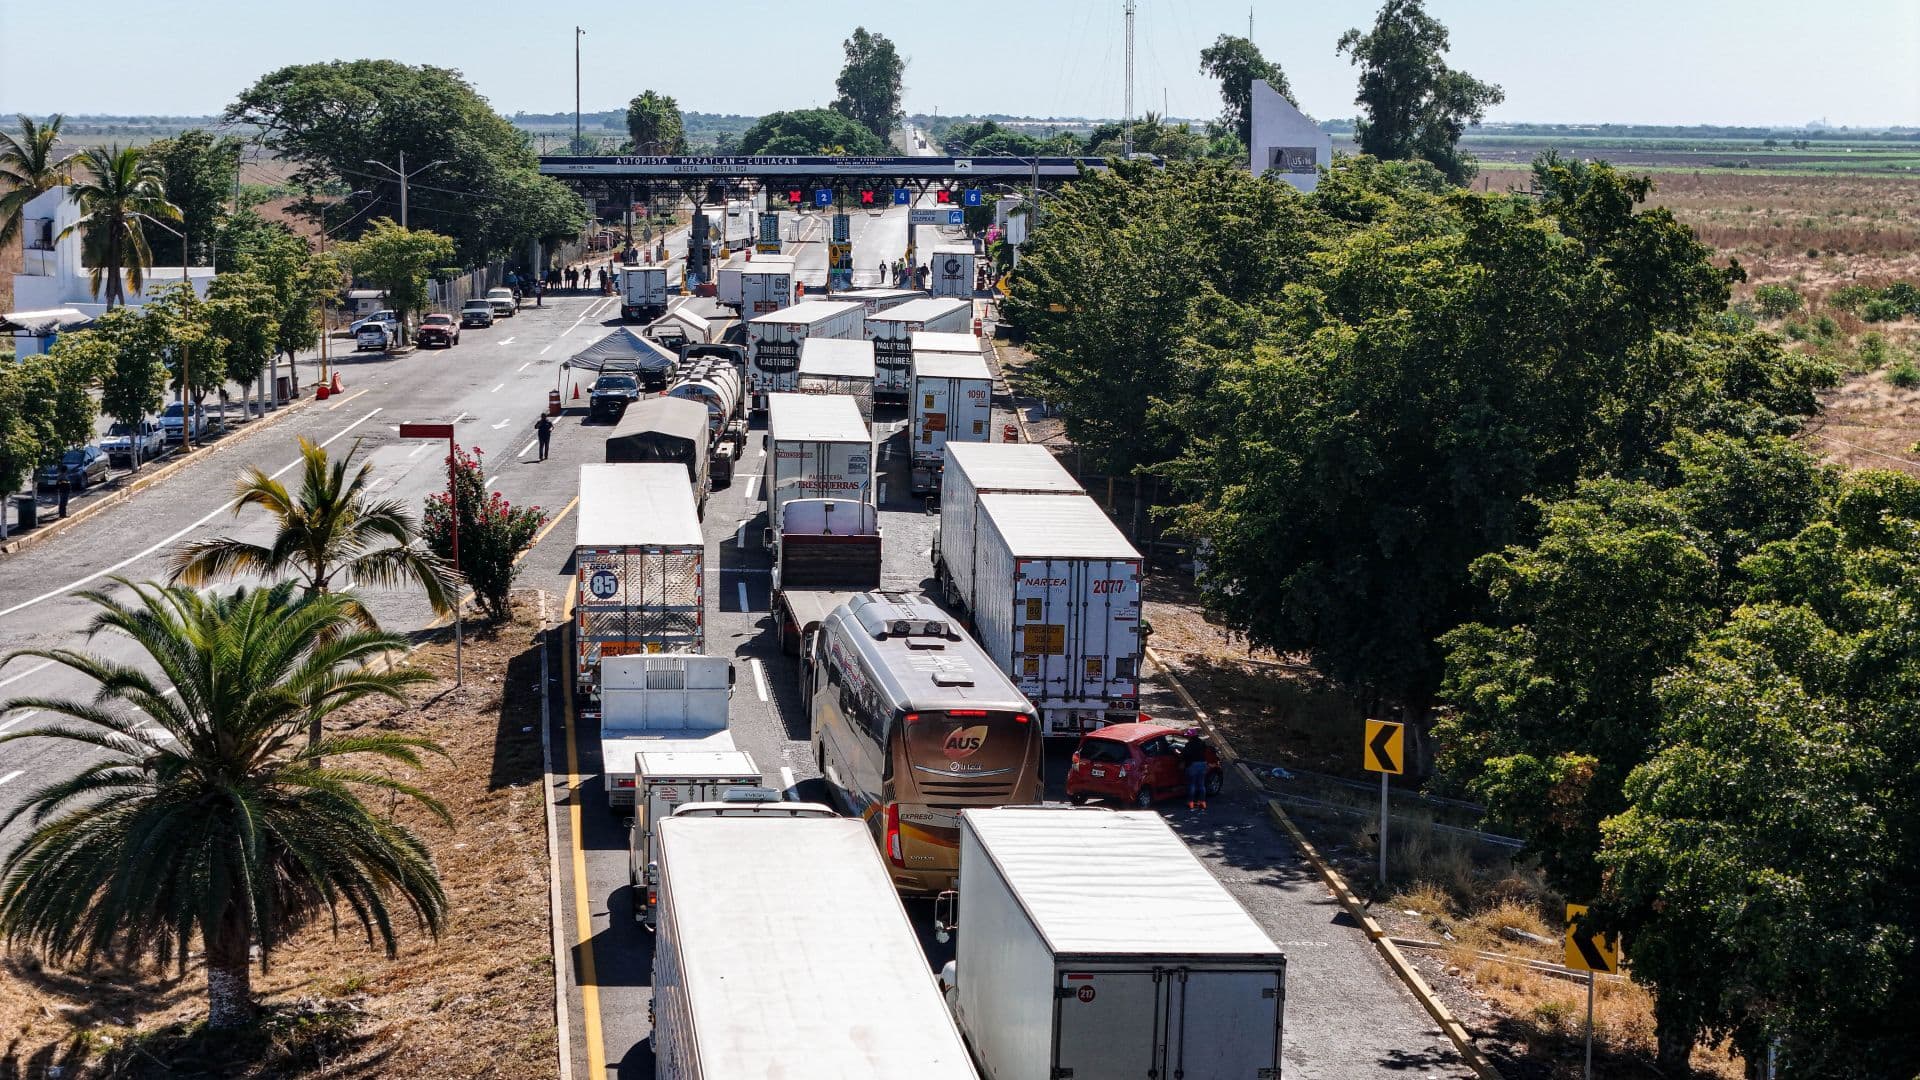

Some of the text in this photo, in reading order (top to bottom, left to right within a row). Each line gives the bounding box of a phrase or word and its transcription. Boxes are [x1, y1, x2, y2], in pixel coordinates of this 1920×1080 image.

[616, 157, 668, 165] AUTOPISTA
[681, 157, 735, 165] MAZATLAN
[747, 157, 798, 165] CULIACAN
[735, 165, 747, 173] RICA
[821, 193, 828, 202] 2
[899, 193, 905, 201] 4
[970, 193, 976, 202] 6
[774, 278, 788, 289] 69
[760, 358, 795, 367] CASTORES
[967, 389, 986, 399] 1090
[592, 575, 617, 595] 85
[1025, 578, 1067, 587] NARCEA
[1093, 579, 1125, 594] 2077
[945, 737, 981, 750] AUS
